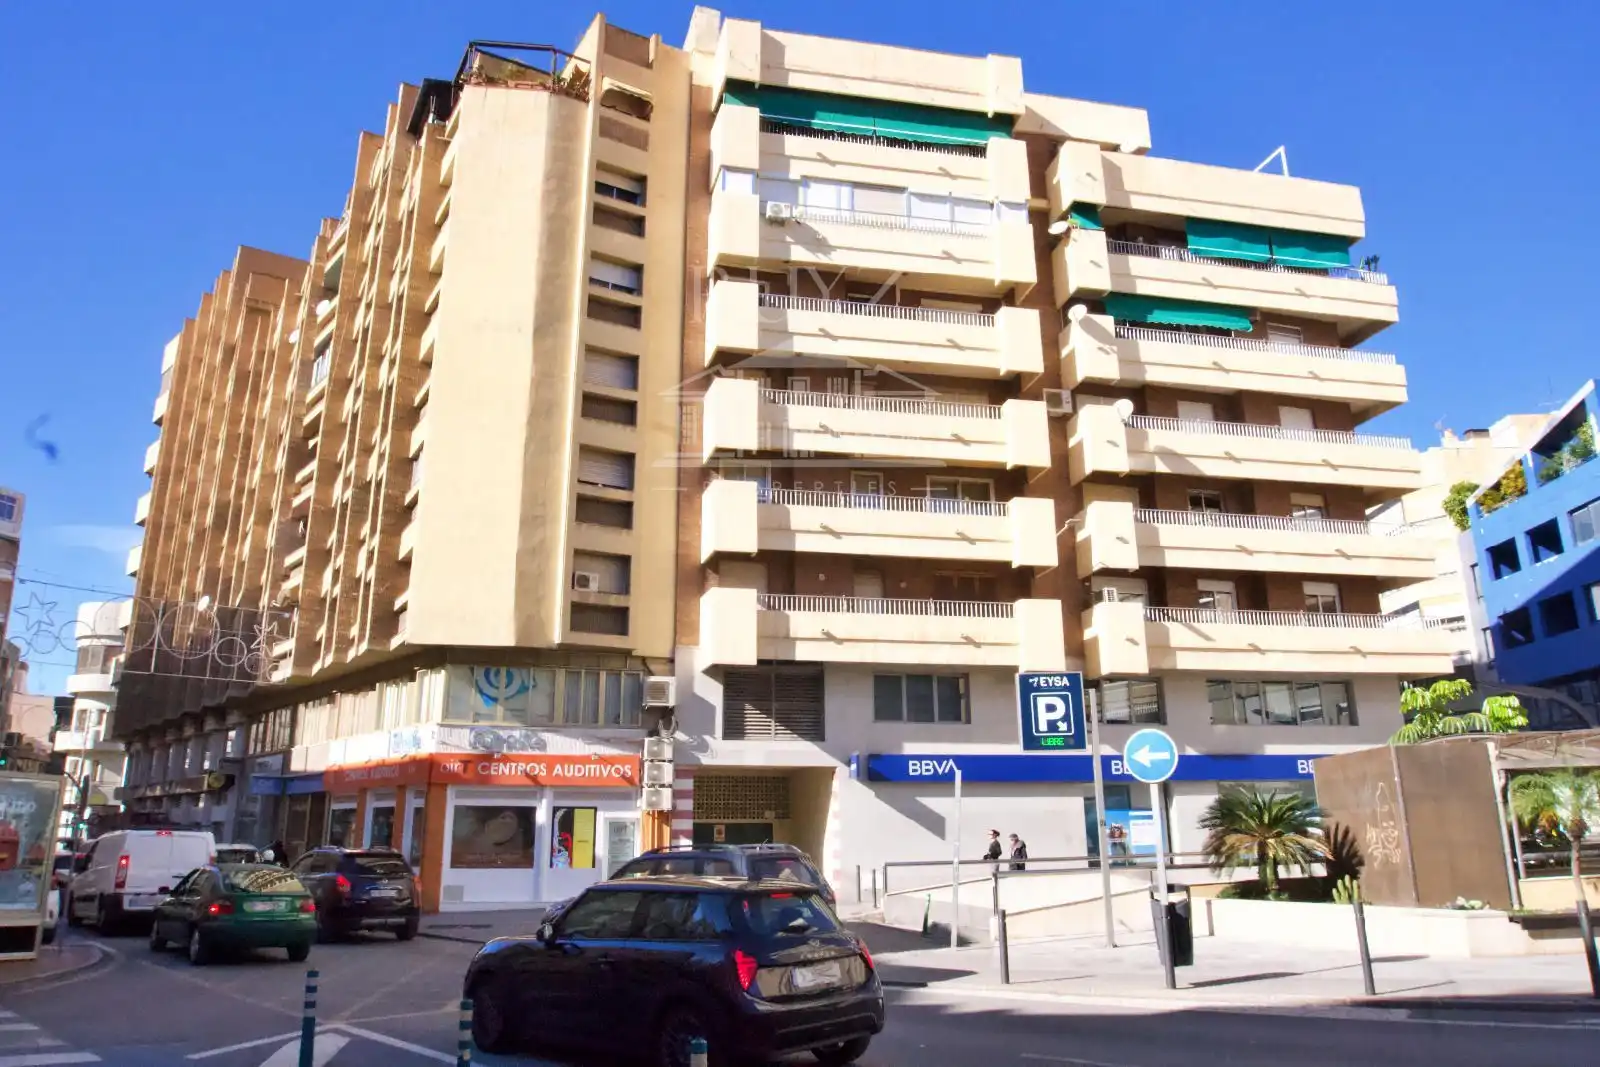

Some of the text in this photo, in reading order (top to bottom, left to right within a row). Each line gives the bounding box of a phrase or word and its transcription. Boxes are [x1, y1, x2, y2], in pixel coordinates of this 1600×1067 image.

[1039, 676, 1070, 687] EYSA
[1041, 737, 1065, 746] LIBRE
[478, 762, 547, 777] CENTROS
[552, 763, 632, 778] AUDITIVOS
[908, 758, 958, 776] BBVA
